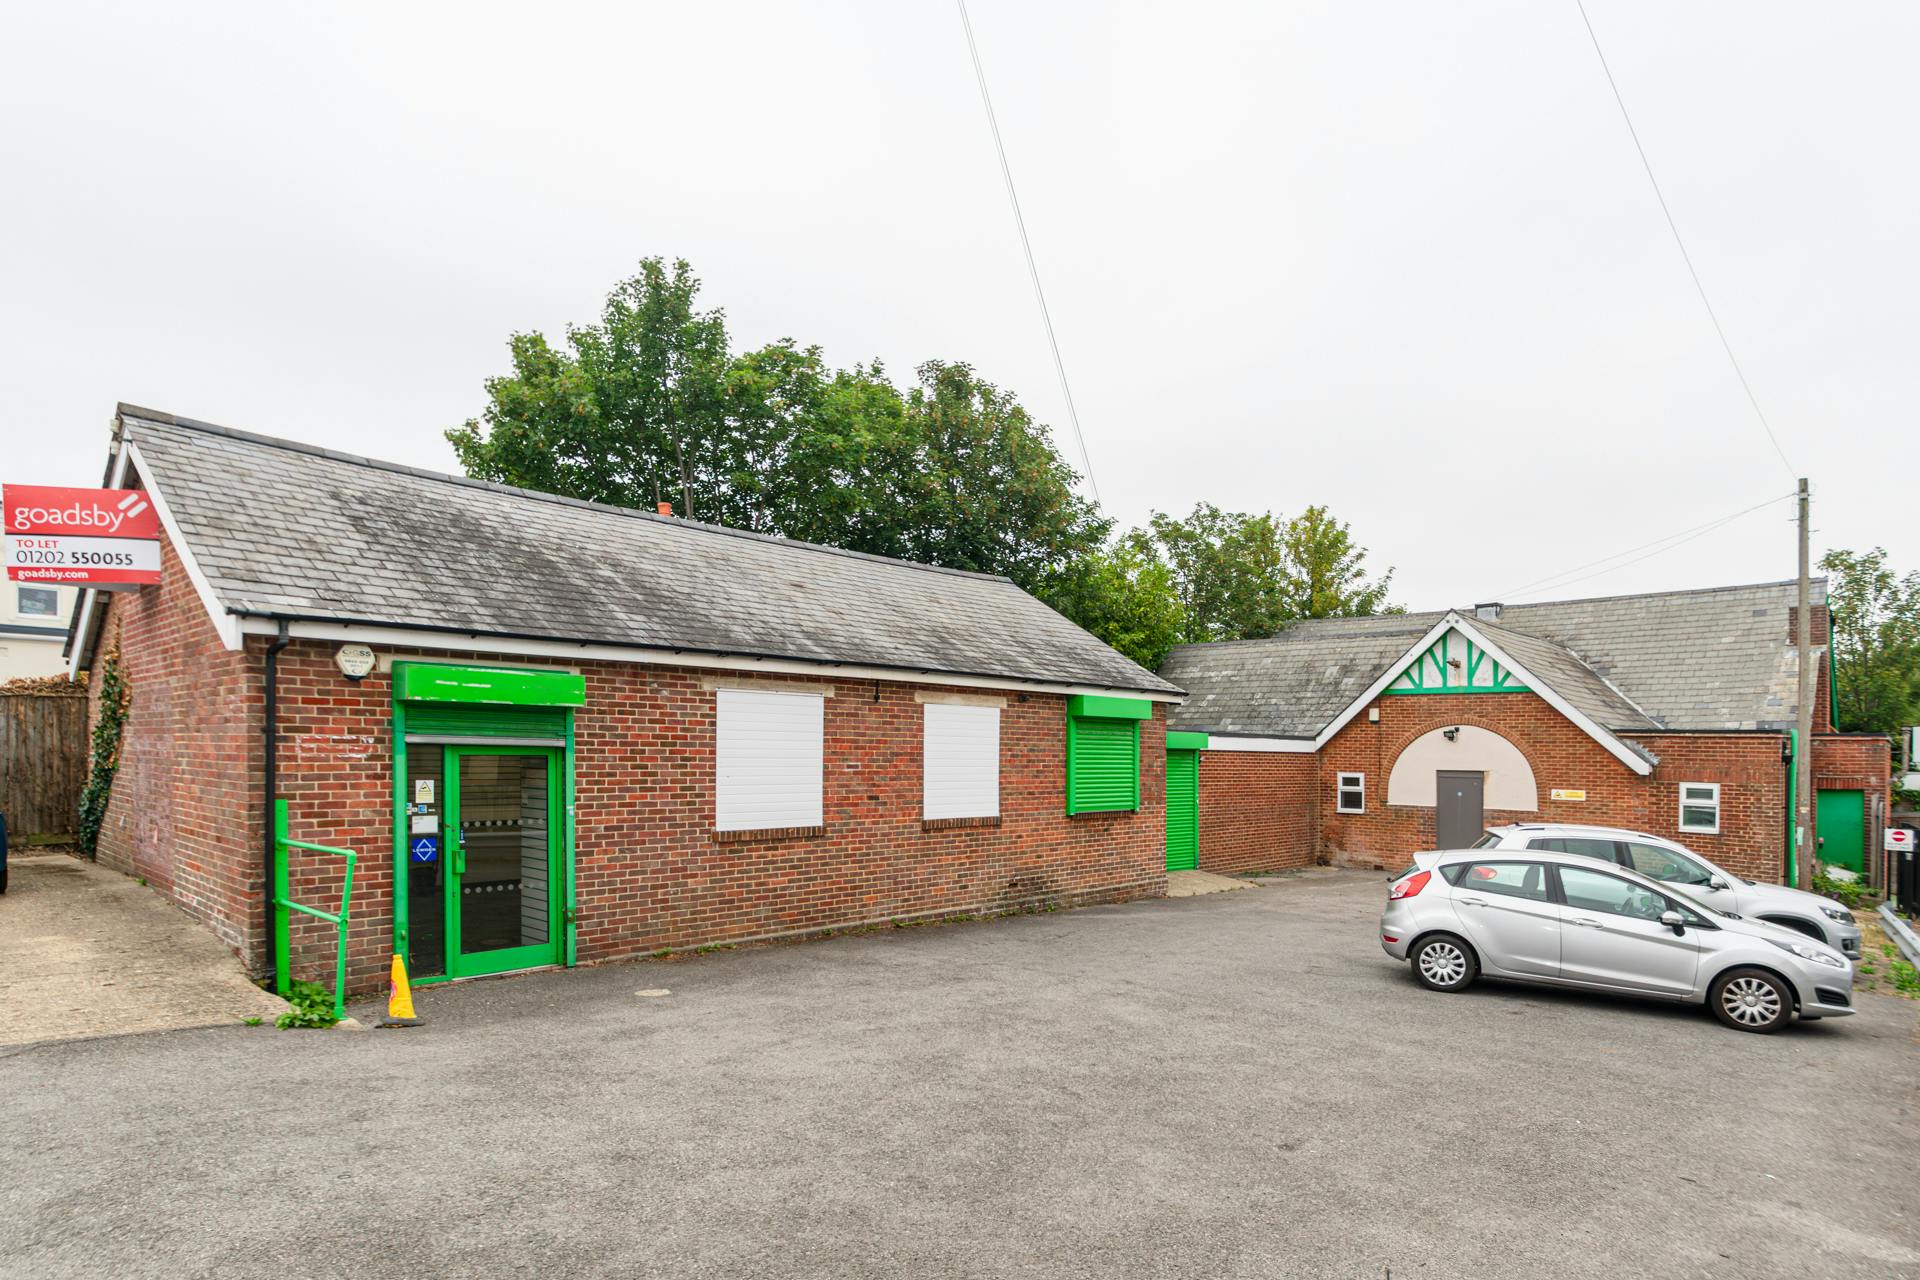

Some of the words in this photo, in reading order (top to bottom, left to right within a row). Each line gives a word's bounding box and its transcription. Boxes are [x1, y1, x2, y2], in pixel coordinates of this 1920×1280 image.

[15, 502, 124, 533] goadsby
[16, 539, 34, 549] TO
[38, 540, 59, 549] LET
[16, 550, 65, 565] 01202
[71, 551, 133, 565] 550055
[17, 568, 89, 580] goadsby.com
